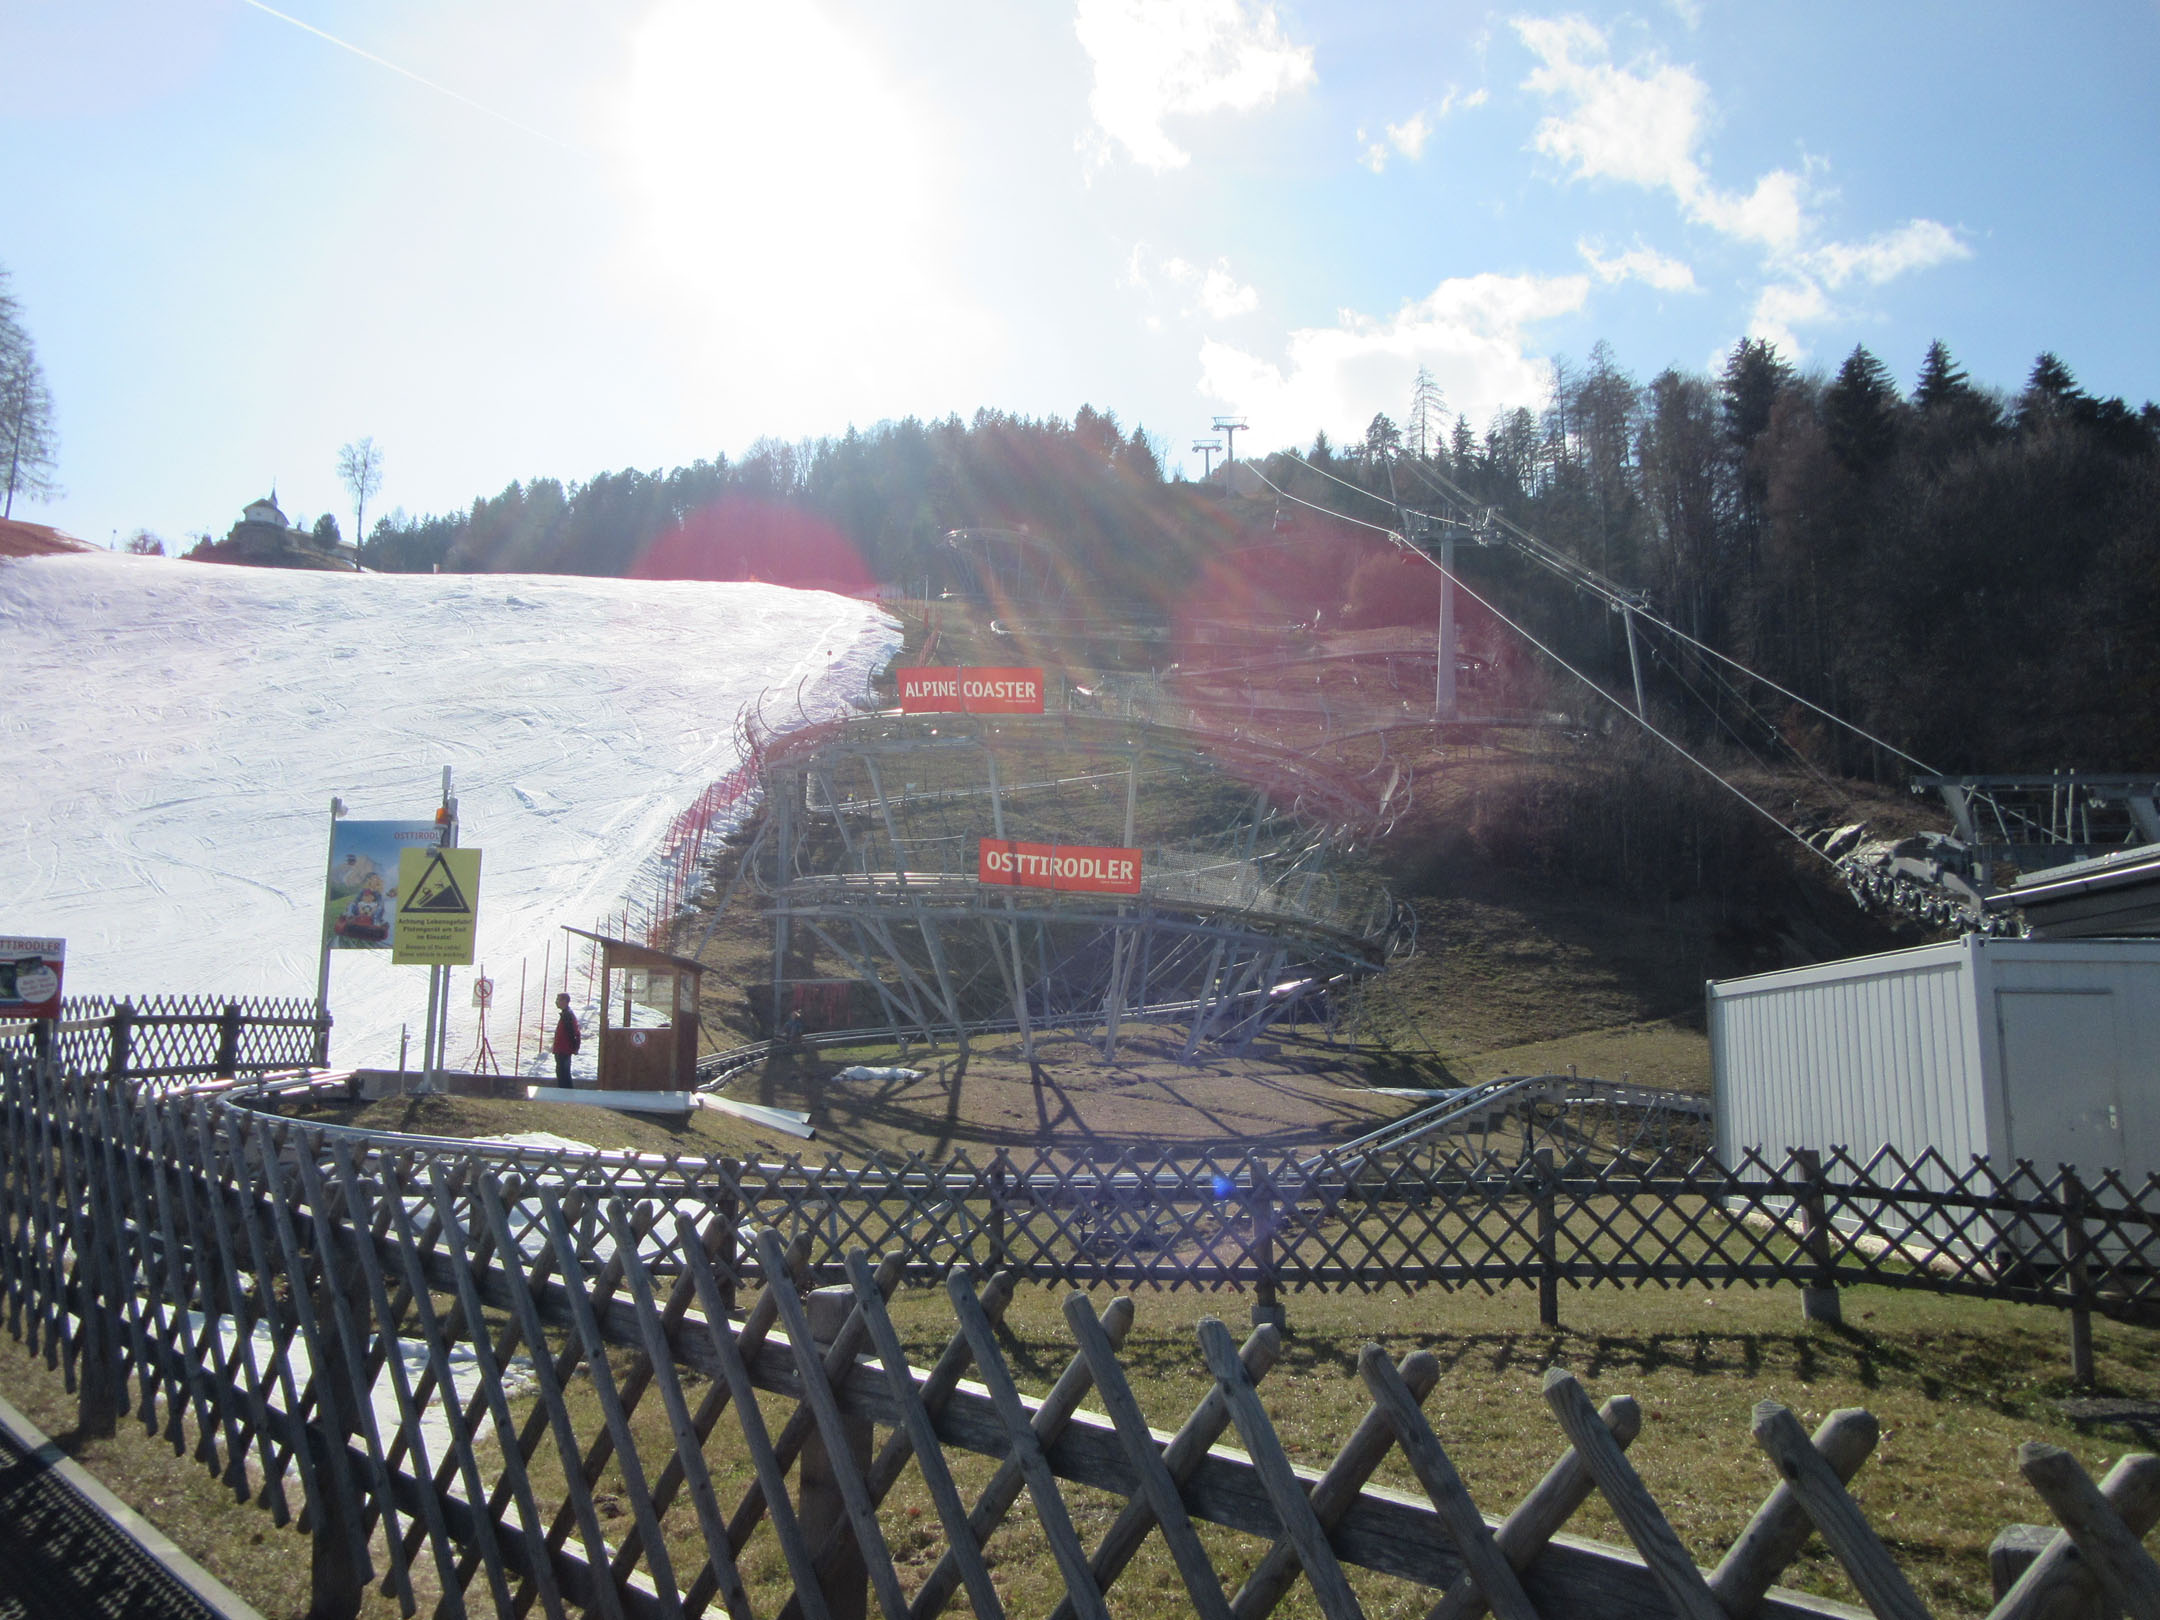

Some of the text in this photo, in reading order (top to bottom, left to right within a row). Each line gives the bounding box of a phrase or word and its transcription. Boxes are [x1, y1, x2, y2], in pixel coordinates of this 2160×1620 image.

[905, 681, 1036, 698] ALPINE COASTER
[394, 831, 441, 841] OSTTIRODL
[986, 851, 1134, 880] OSTTIRODLER
